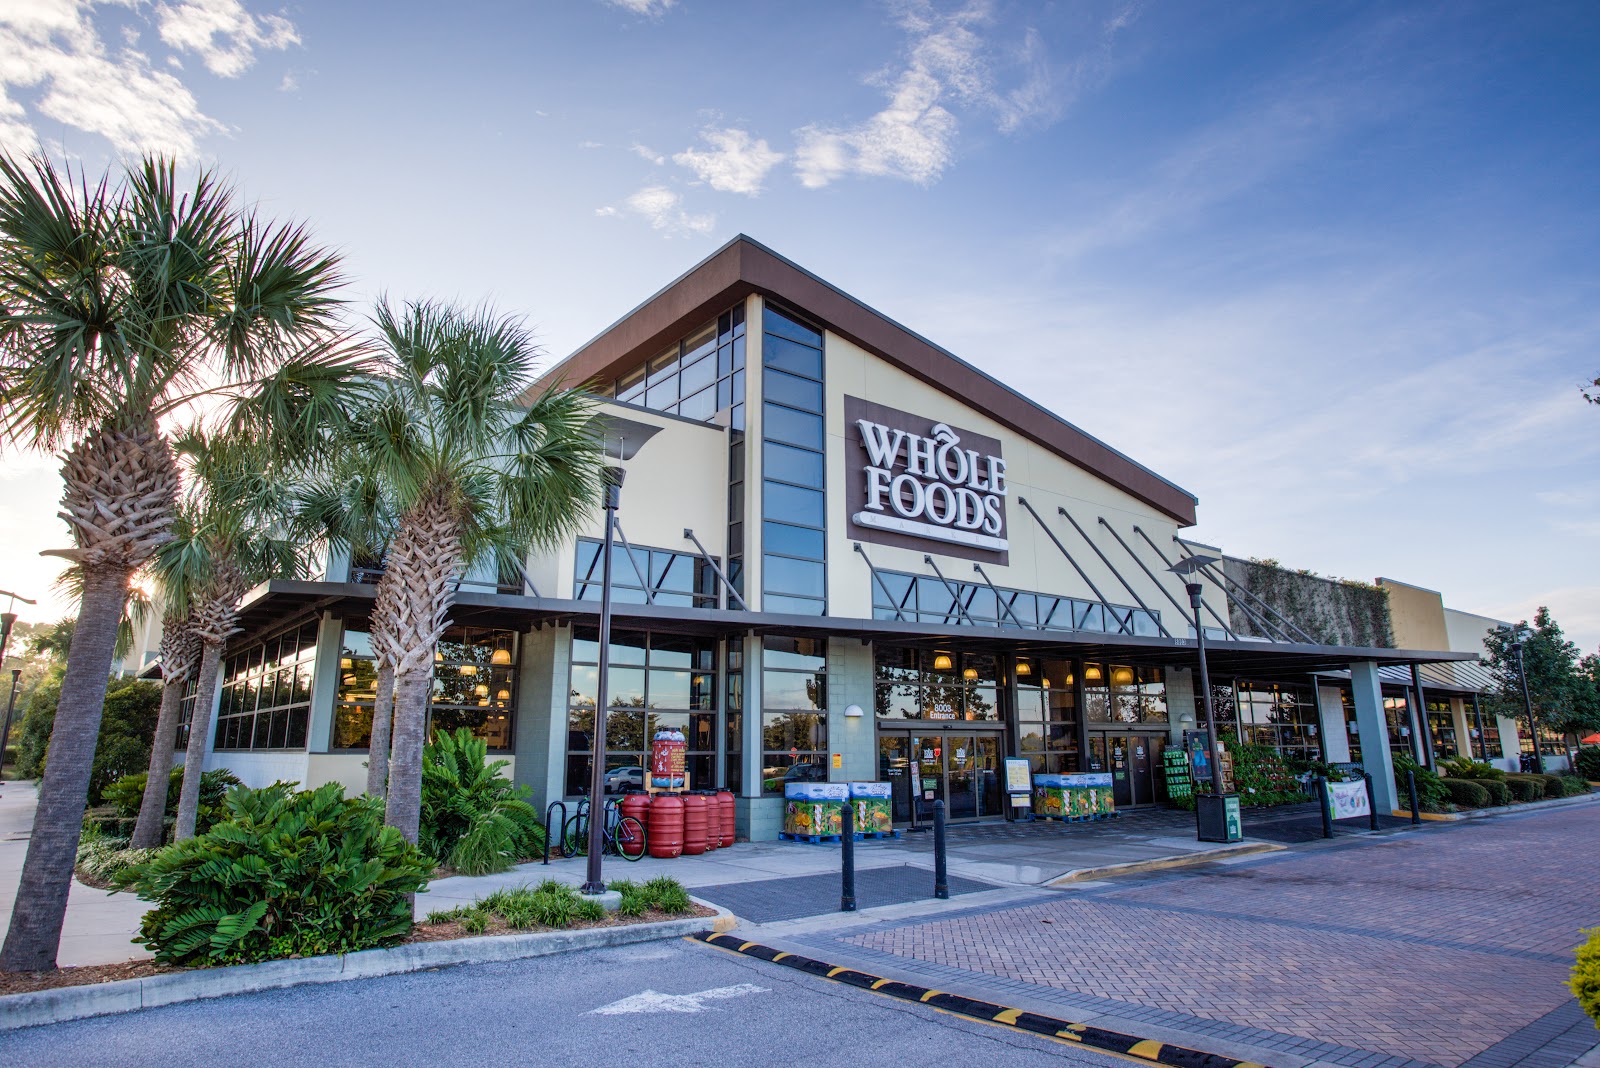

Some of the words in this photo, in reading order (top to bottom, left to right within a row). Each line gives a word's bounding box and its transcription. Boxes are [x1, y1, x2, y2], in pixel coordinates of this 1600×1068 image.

[856, 419, 1007, 495] WHOLE
[863, 466, 1002, 536] FOODS
[869, 515, 1002, 548] MARKET
[930, 710, 956, 719] Entrance
